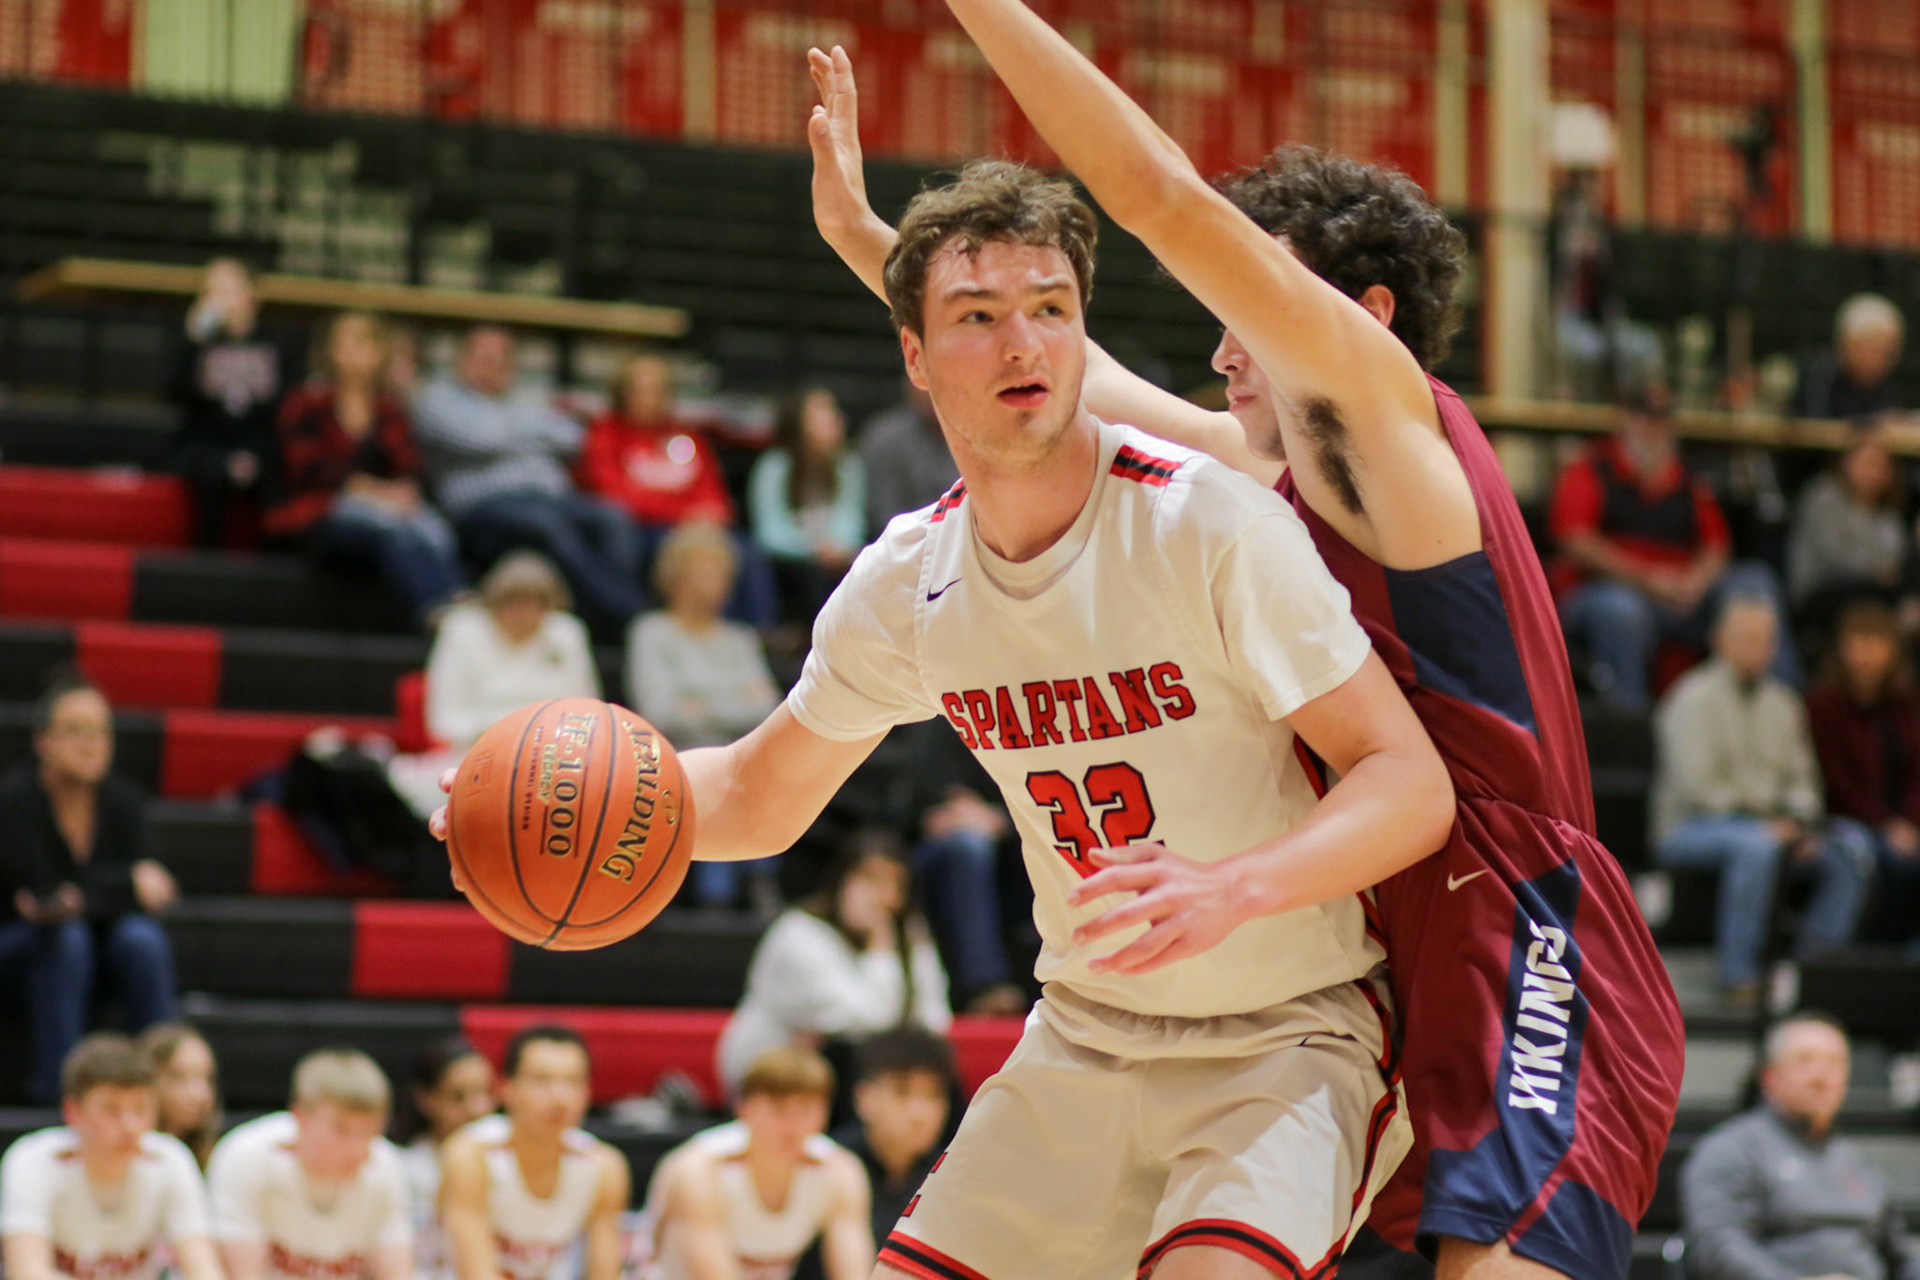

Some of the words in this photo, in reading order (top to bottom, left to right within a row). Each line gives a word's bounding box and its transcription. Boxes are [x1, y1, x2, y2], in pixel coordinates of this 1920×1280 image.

[941, 661, 1197, 750] SPARTANS
[600, 720, 661, 884] SPALDING
[1025, 761, 1166, 880] 32
[1508, 918, 1576, 1116] VIKINGS
